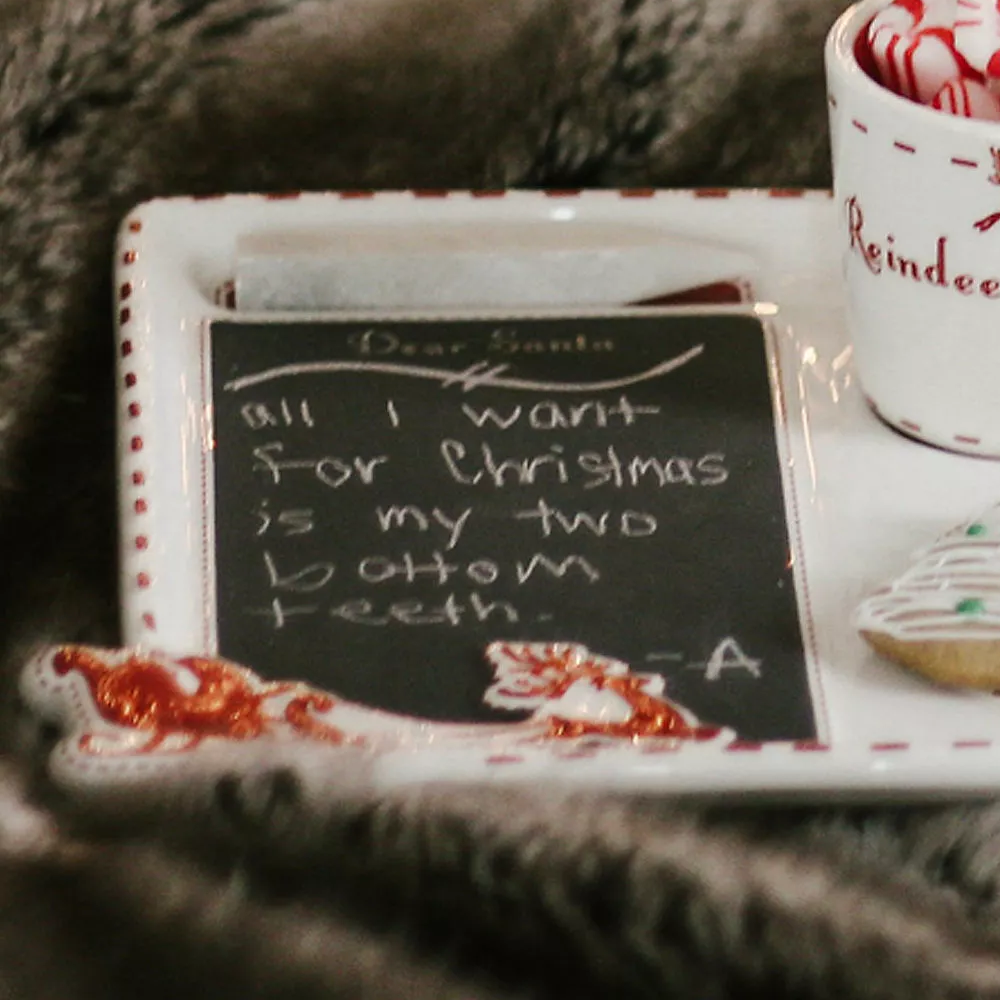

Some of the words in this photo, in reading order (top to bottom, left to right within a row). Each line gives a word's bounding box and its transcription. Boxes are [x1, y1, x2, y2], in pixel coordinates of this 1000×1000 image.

[349, 329, 466, 356] Dear
[488, 328, 614, 352] Santa
[241, 399, 314, 429] all
[462, 396, 661, 430] want
[440, 439, 729, 487] Christmas
[256, 501, 314, 536] is
[377, 503, 472, 549] my
[516, 499, 658, 537] two
[263, 552, 600, 590] bottom
